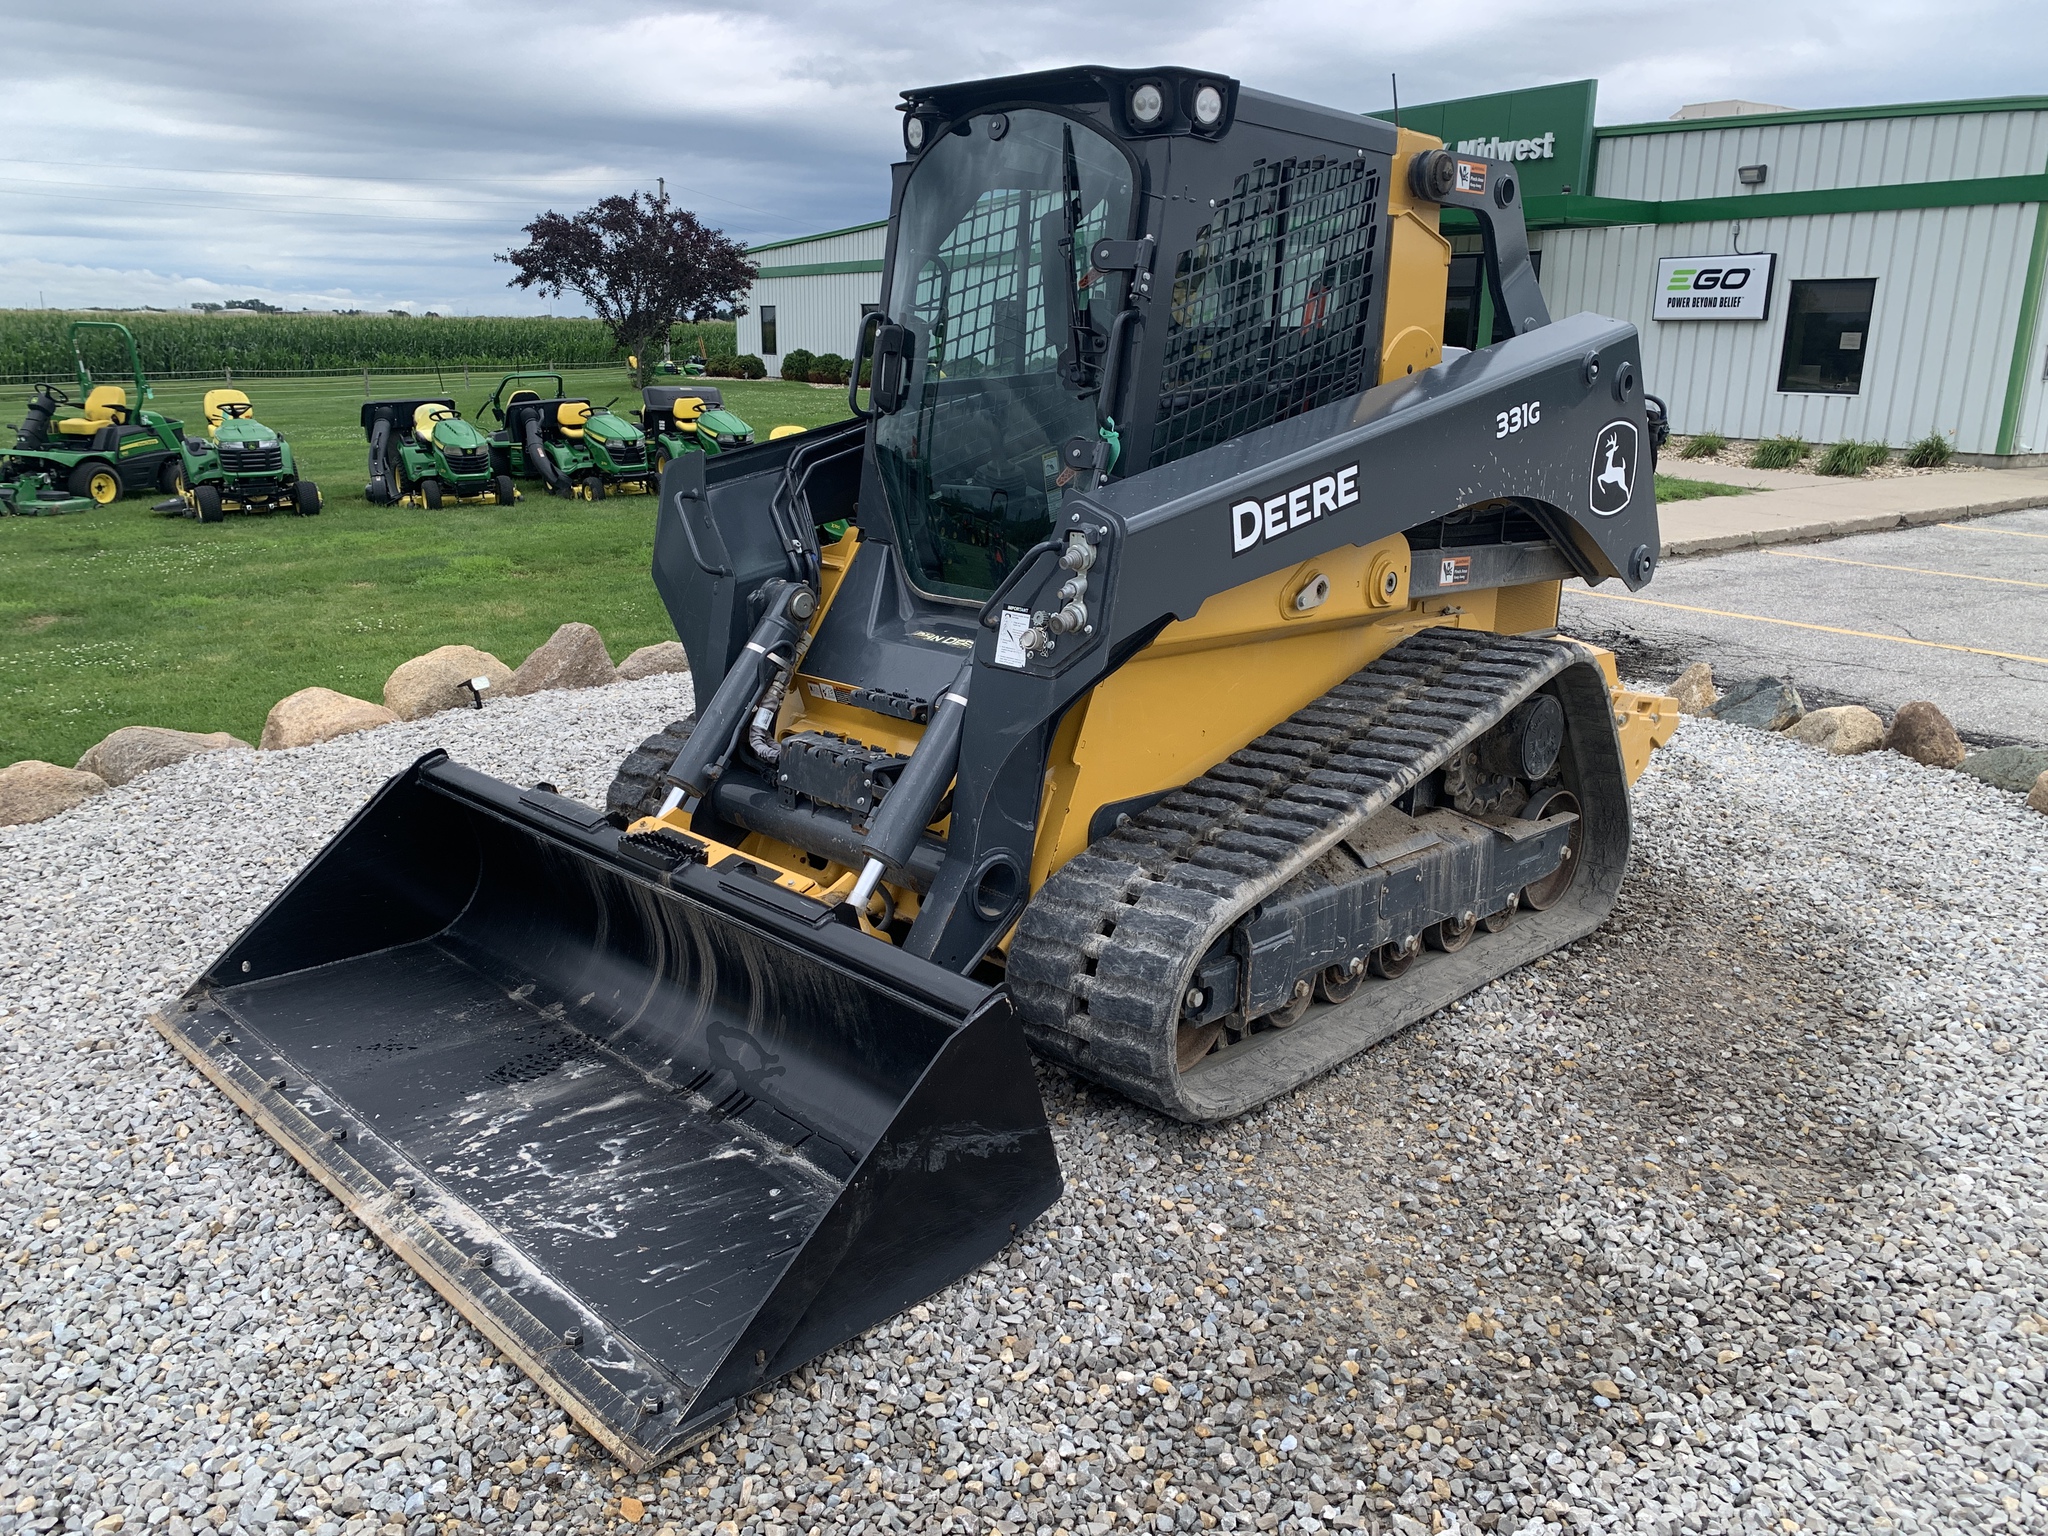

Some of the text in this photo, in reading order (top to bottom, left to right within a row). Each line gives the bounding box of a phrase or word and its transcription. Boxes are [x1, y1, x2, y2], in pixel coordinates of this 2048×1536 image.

[1457, 132, 1555, 161] Midwest
[1666, 268, 1751, 291] EGO
[1666, 296, 1742, 308] POWER BEYOND BELIEF
[1496, 401, 1540, 439] 331G
[1231, 464, 1359, 553] DEERE
